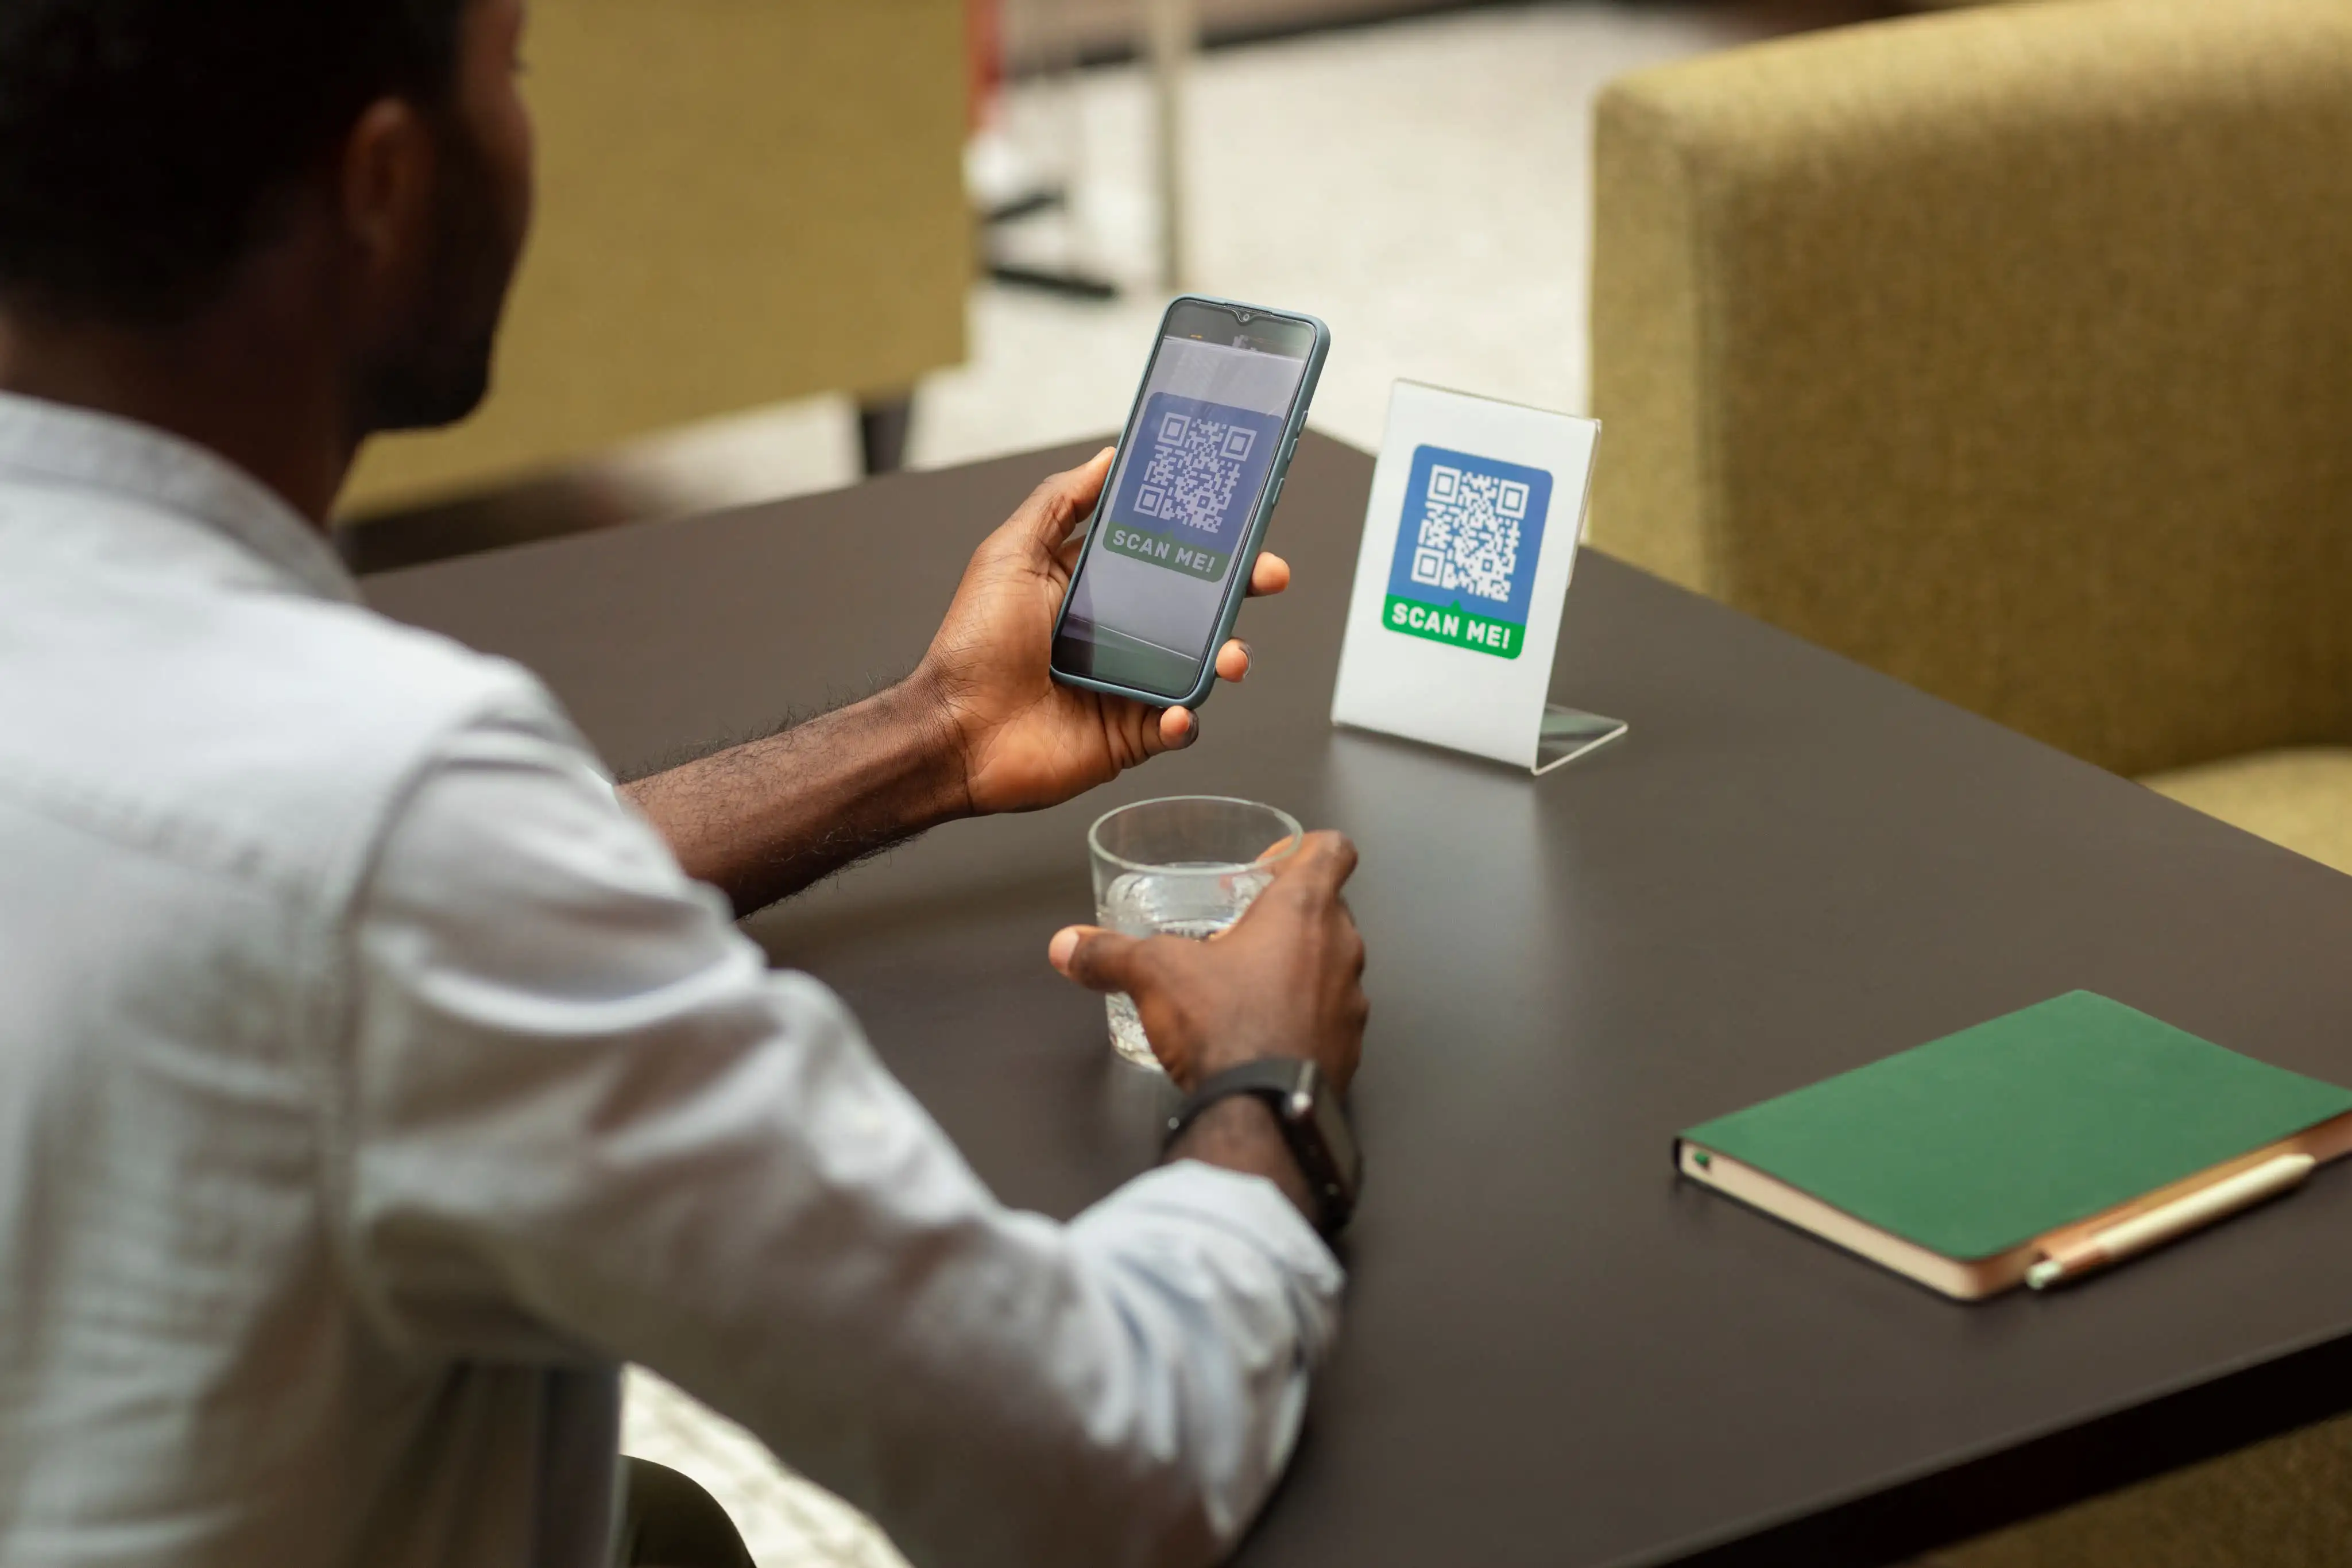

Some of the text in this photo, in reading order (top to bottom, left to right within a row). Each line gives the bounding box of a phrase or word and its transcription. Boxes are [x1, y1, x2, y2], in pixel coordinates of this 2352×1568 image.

[1113, 530, 1216, 573] SCAN ME!
[1392, 602, 1511, 649] SCAN ME!
